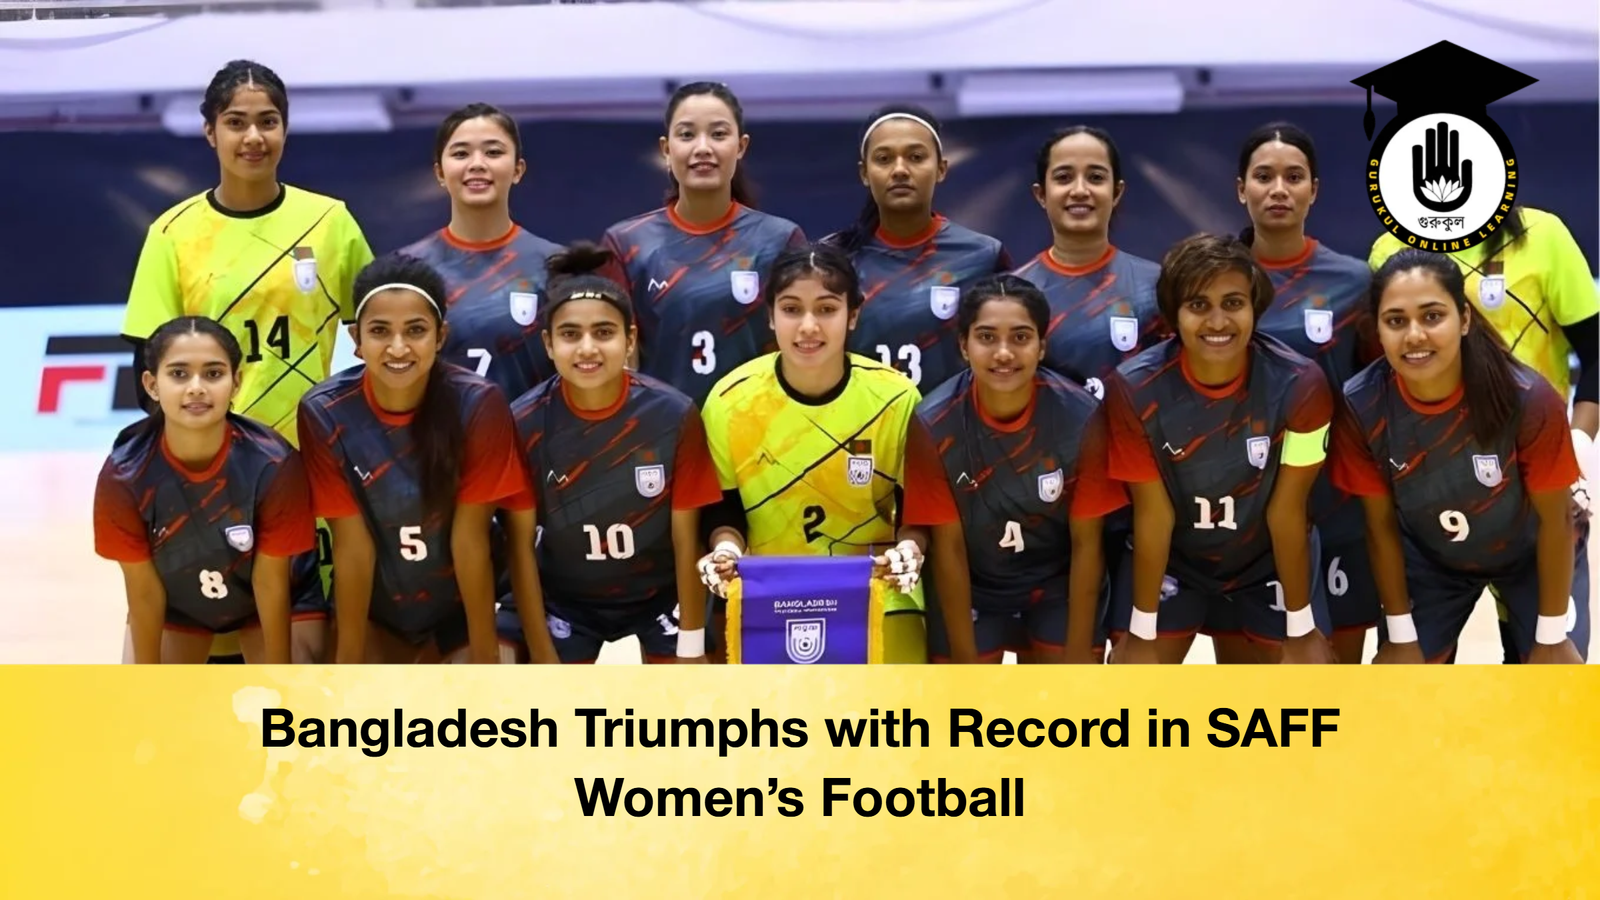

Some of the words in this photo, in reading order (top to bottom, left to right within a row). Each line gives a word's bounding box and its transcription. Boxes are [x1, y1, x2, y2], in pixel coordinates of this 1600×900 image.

[244, 315, 290, 363] 14
[691, 330, 716, 375] 3
[467, 348, 492, 377] 7
[875, 343, 922, 387] 13
[803, 505, 826, 543] 2
[1193, 495, 1237, 530] 11
[1439, 509, 1470, 542] 9
[400, 526, 428, 562] 5
[583, 523, 634, 560] 10
[999, 520, 1024, 552] 4
[199, 569, 228, 599] 8
[1327, 556, 1349, 597] 6
